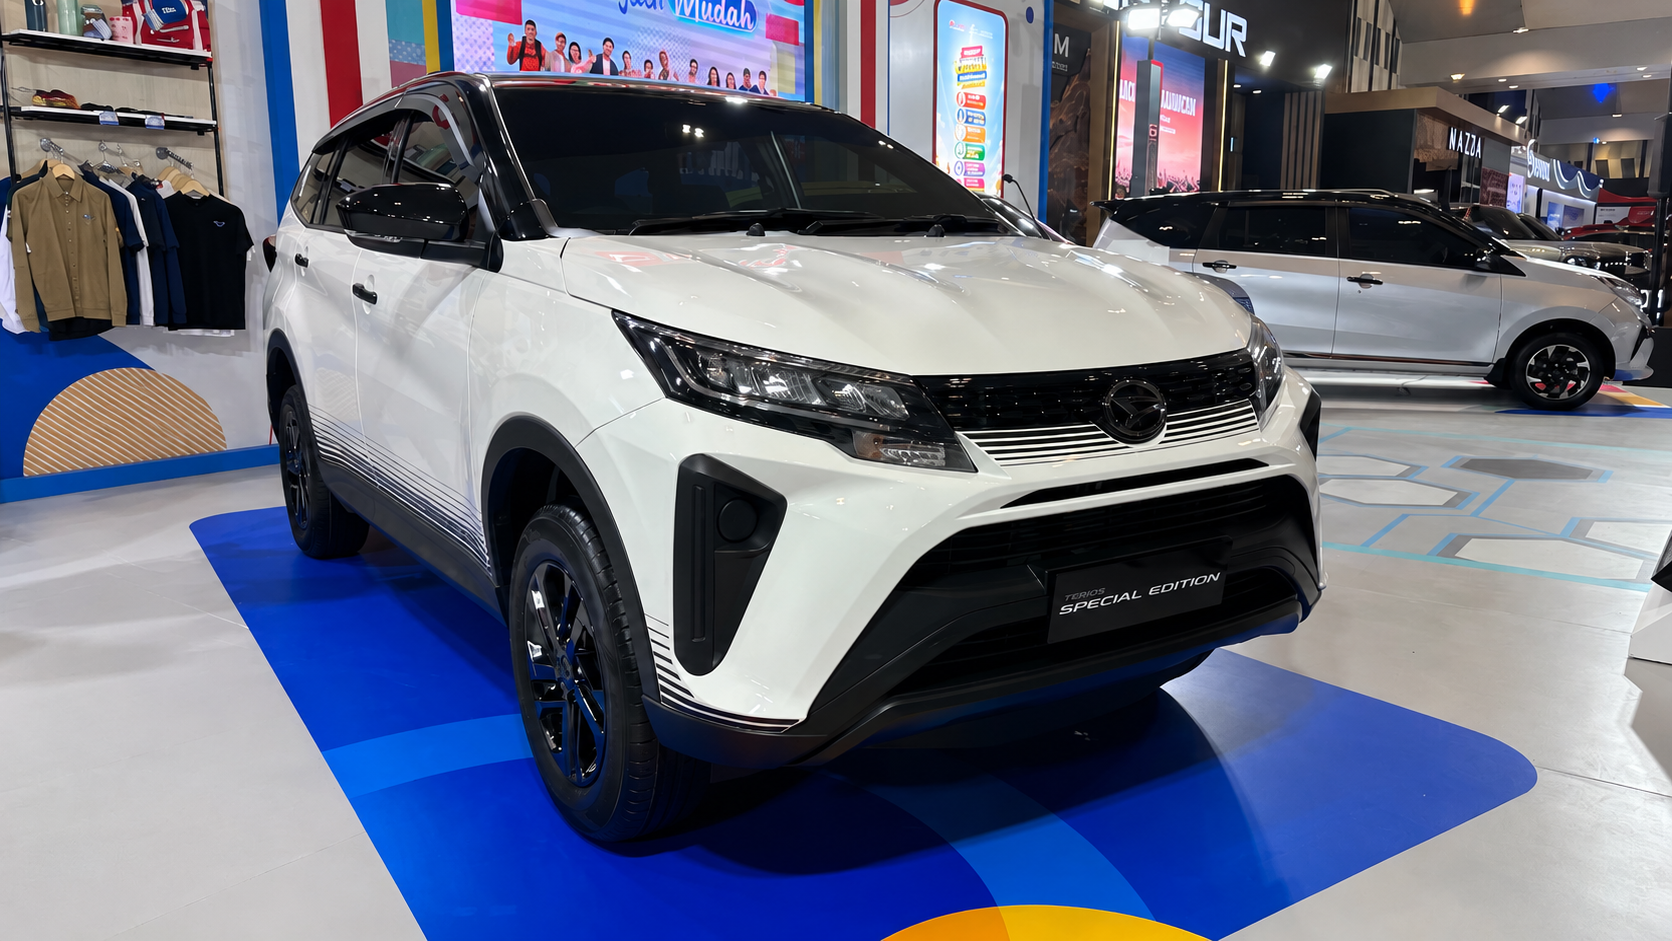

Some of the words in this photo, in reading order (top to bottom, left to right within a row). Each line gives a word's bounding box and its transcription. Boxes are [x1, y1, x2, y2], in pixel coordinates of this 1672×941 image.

[675, 0, 755, 30] Mudah
[1059, 590, 1142, 616] SPECIAL
[1148, 572, 1221, 596] EDITION
[1064, 587, 1106, 602] TERIOS
